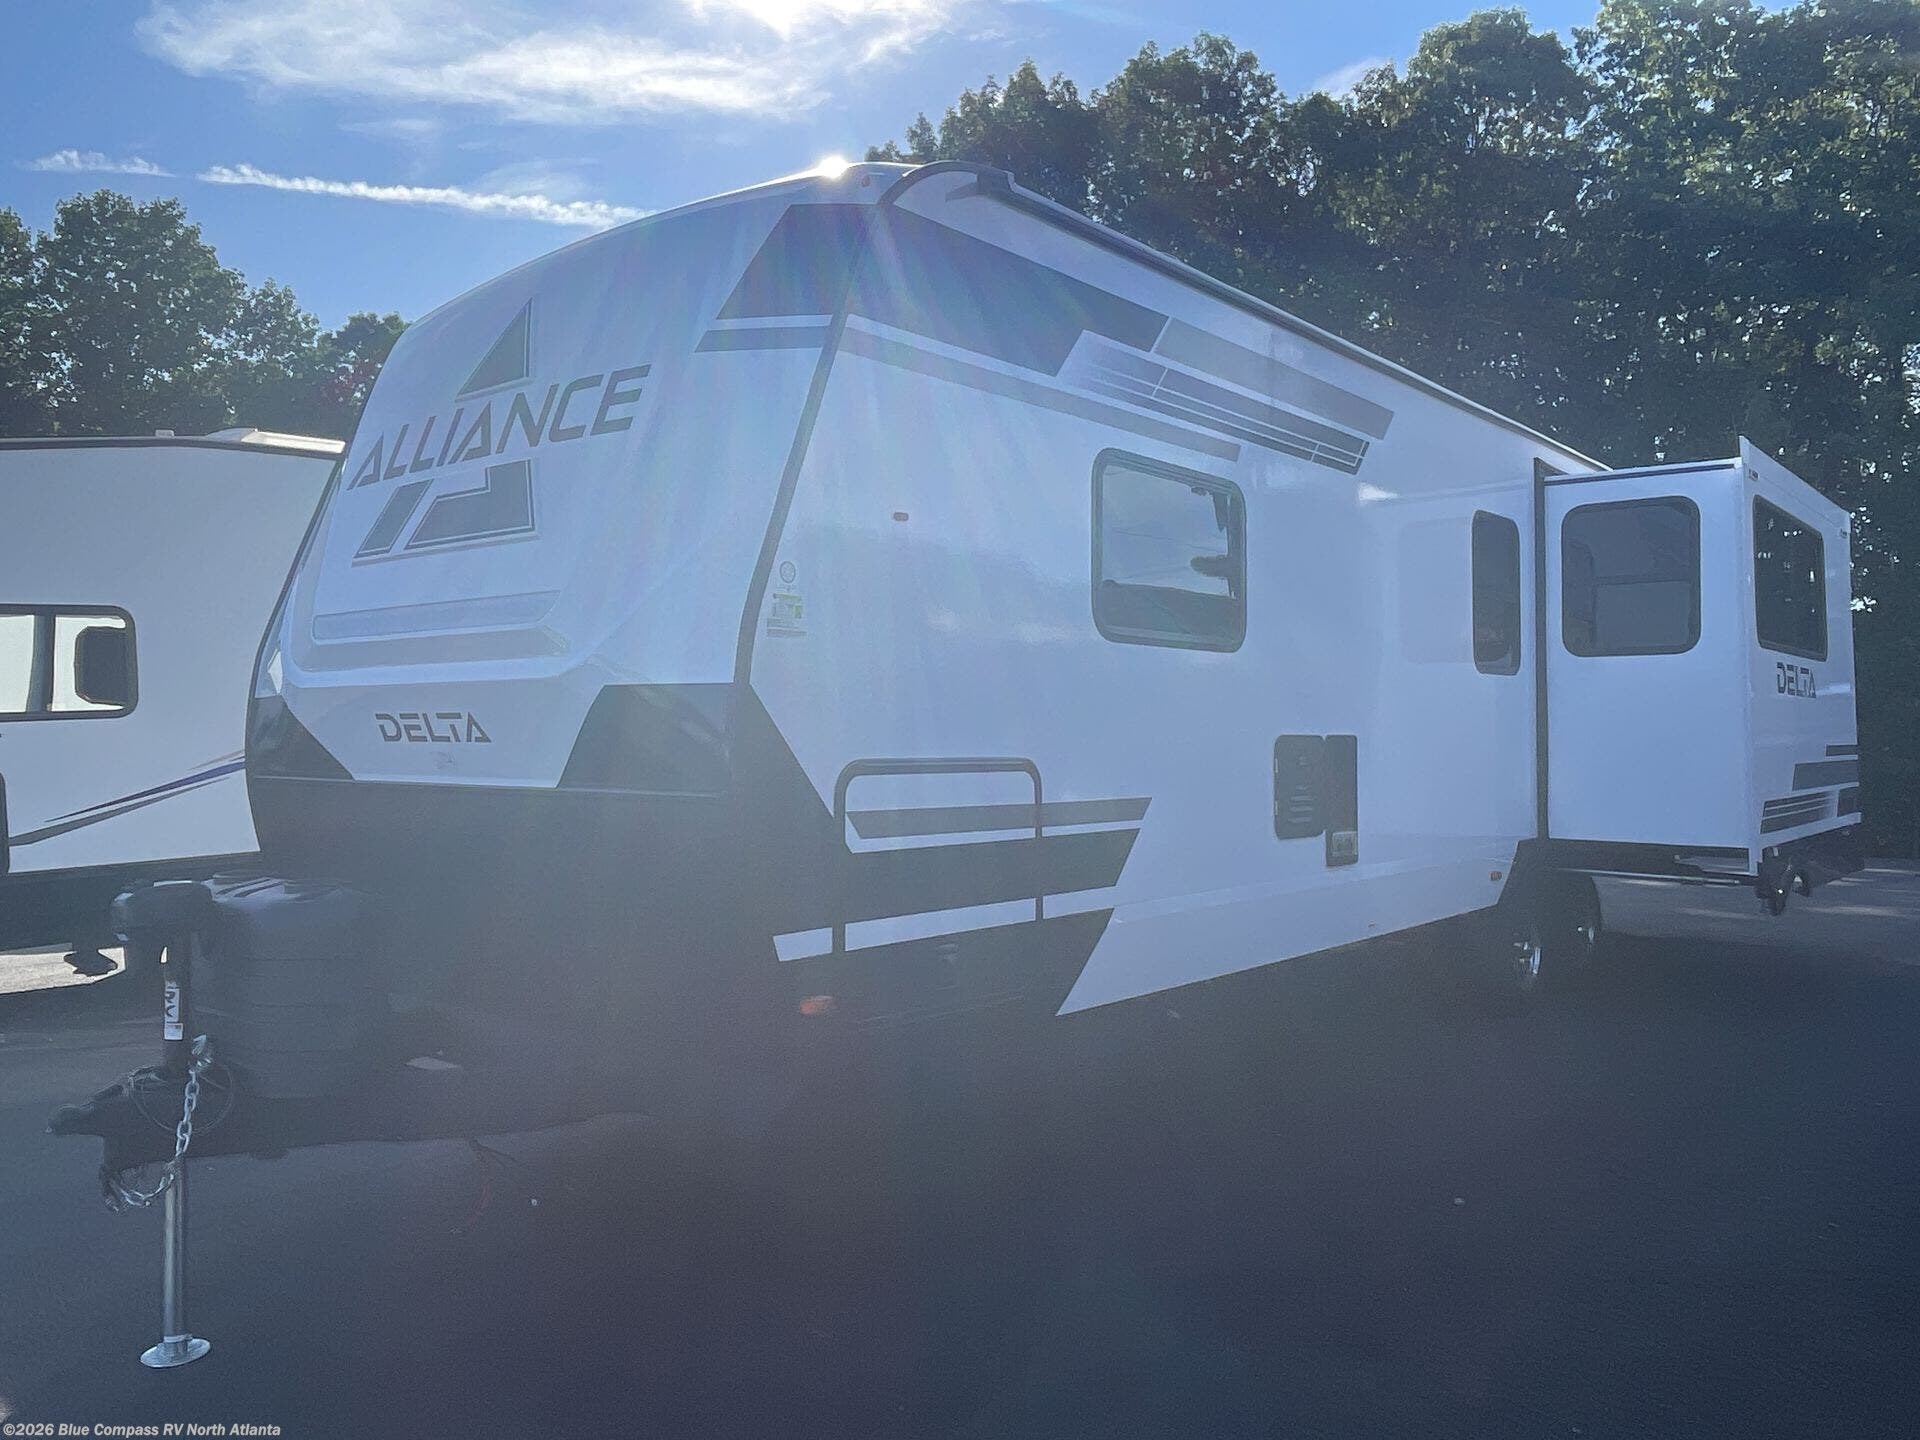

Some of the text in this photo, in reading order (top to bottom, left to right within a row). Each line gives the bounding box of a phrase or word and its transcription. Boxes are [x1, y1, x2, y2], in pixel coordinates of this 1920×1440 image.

[347, 364, 652, 490] ALLIANCE
[1776, 661, 1817, 698] DELTA
[375, 711, 492, 743] DELTA
